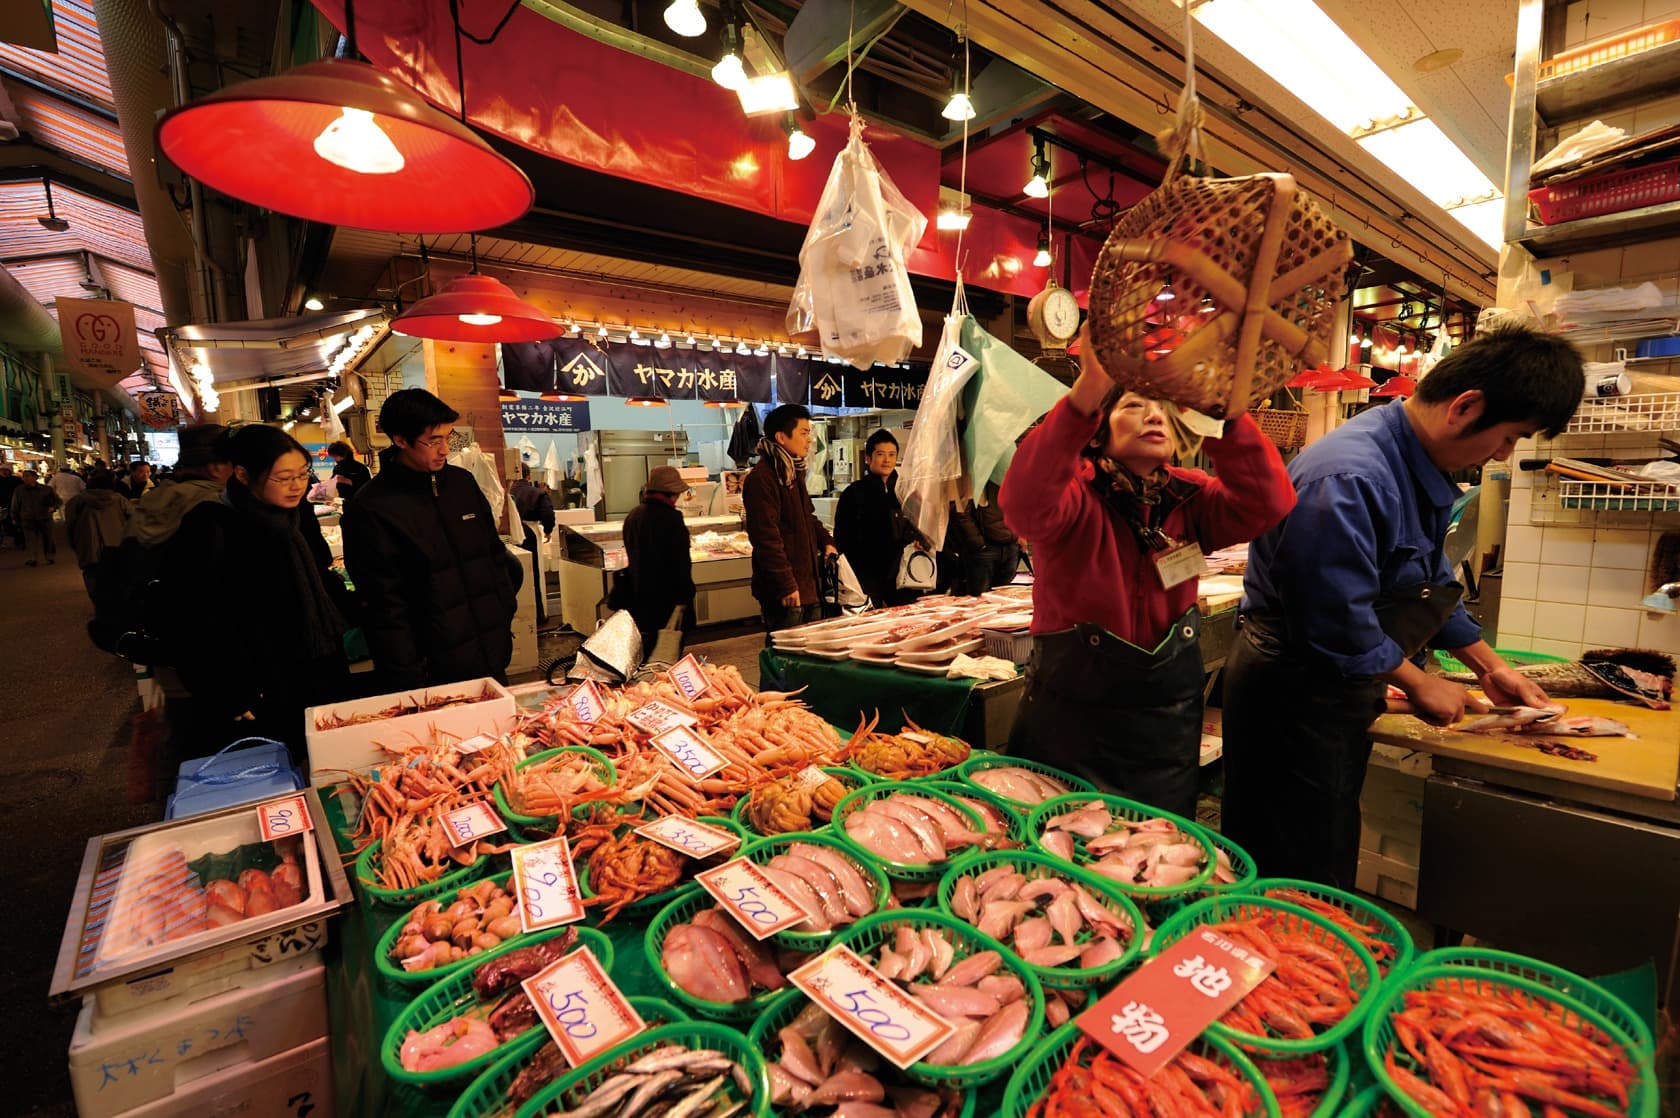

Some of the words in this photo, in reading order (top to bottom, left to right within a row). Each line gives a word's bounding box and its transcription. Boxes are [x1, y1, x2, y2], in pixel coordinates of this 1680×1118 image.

[633, 363, 736, 390] ヤマカ水産
[502, 411, 573, 426] ヤマカ水産
[673, 740, 708, 774] 3500
[269, 809, 293, 832] 900
[520, 872, 558, 918] 900
[724, 887, 778, 924] 500
[549, 990, 597, 1038] 500
[829, 990, 911, 1041] 500
